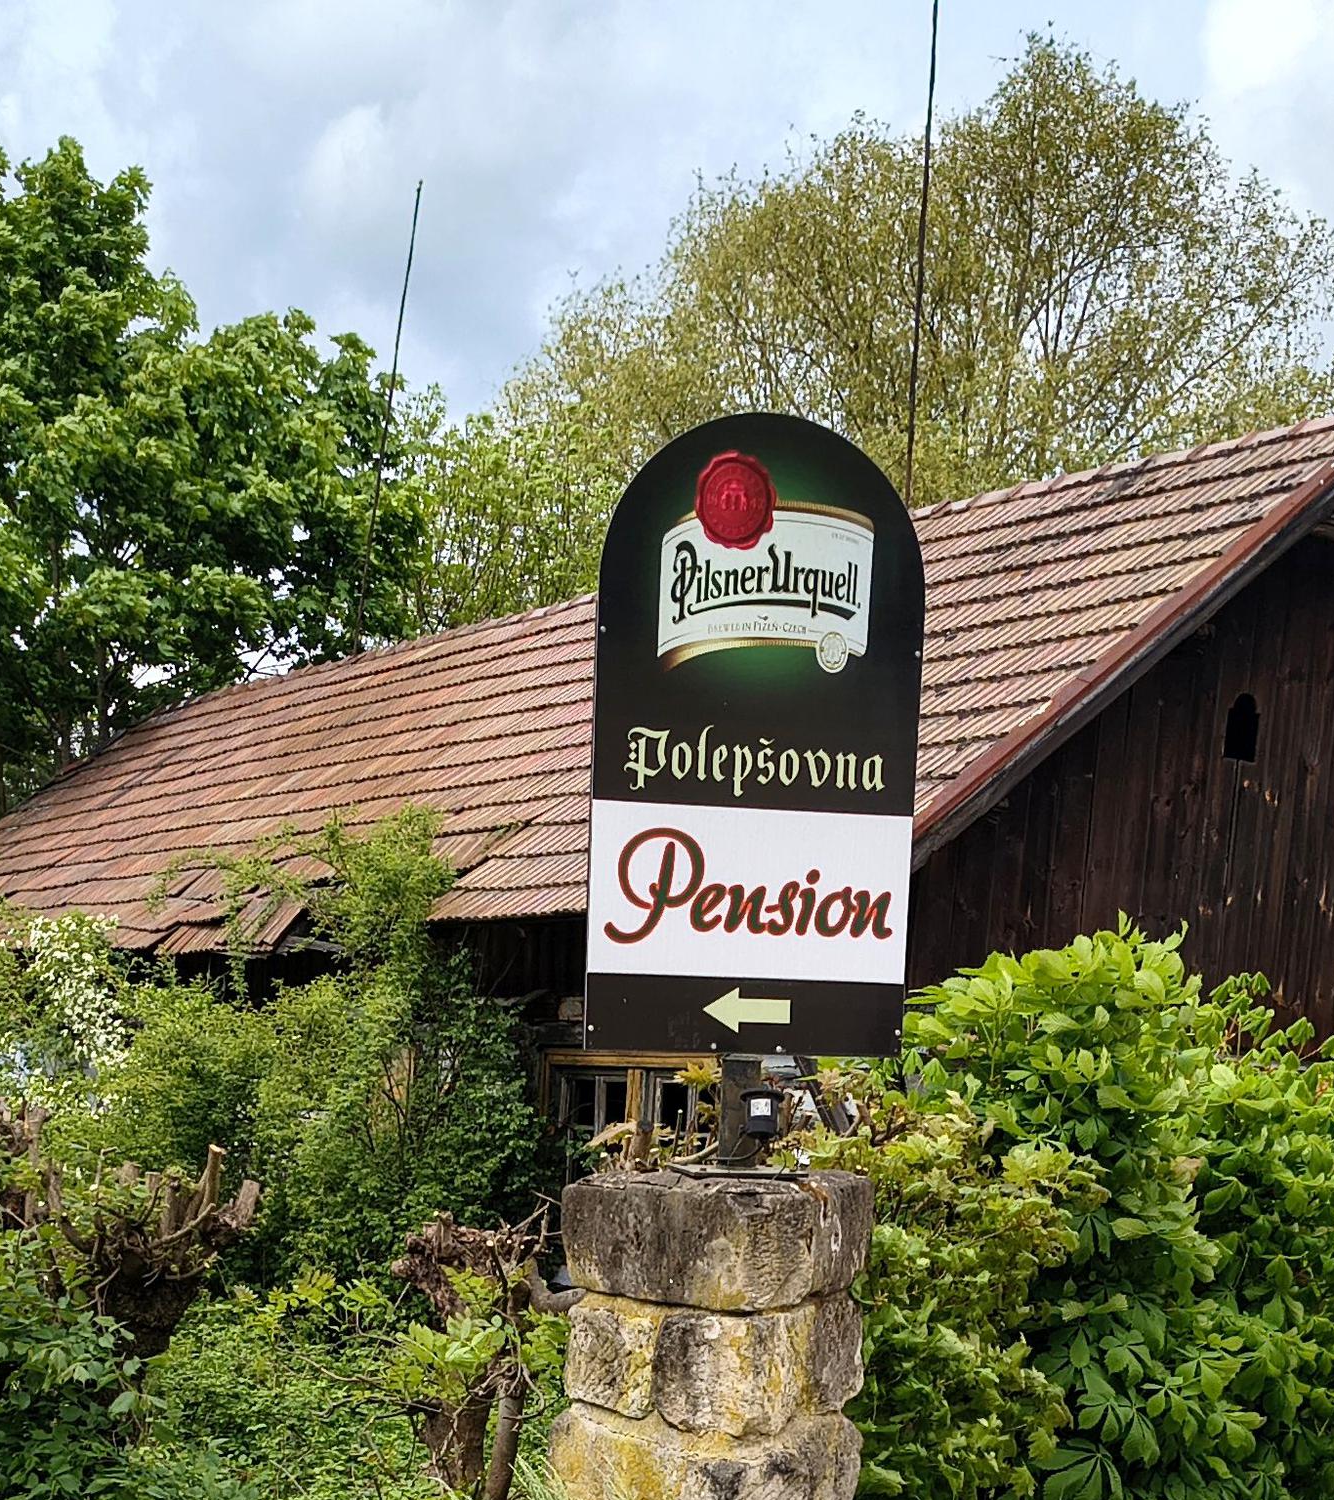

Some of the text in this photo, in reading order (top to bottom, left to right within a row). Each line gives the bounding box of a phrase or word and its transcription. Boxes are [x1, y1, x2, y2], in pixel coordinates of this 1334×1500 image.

[670, 540, 770, 625] Pilsner
[742, 622, 751, 631] IN
[623, 724, 886, 798] Polepšovna
[604, 827, 893, 944] Pension
